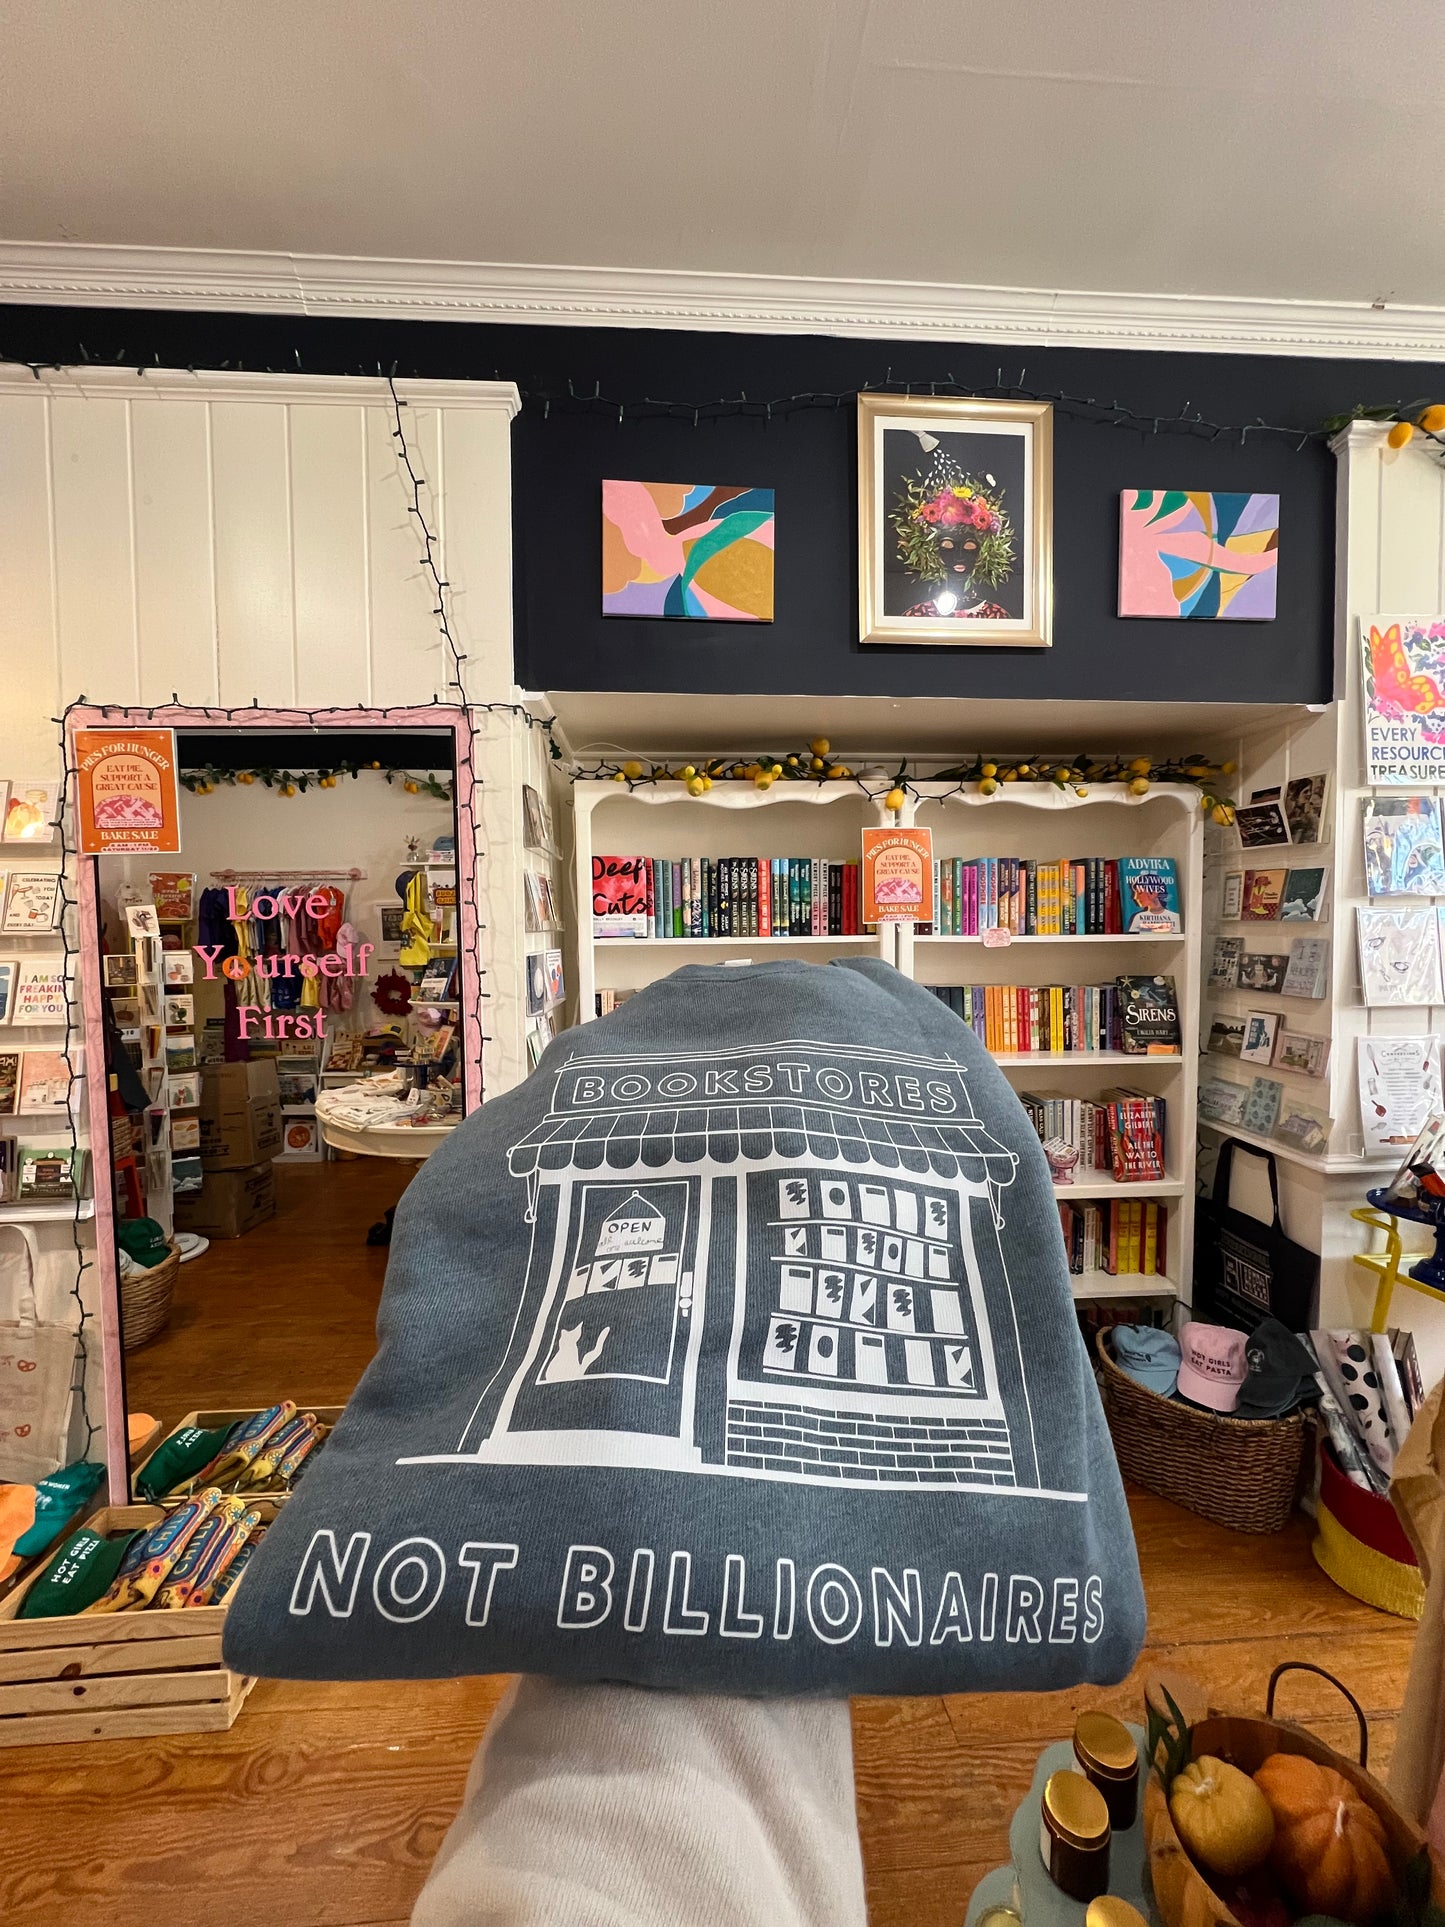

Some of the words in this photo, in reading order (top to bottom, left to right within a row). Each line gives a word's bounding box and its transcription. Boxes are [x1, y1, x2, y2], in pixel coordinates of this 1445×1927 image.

[1371, 727, 1417, 742] EVERY
[81, 750, 102, 772] PIES
[101, 743, 125, 756] FOR
[127, 743, 170, 771] HUNGER
[106, 764, 126, 773] EAT
[144, 773, 151, 781] A
[95, 783, 126, 791] GREAT
[127, 783, 158, 791] CAUSE
[101, 831, 131, 840] BAKE
[132, 830, 159, 840] SALE
[866, 843, 883, 860] PIES
[881, 838, 900, 848] FOR
[900, 838, 930, 859] HUNGER
[592, 856, 646, 885] Deep
[1127, 858, 1170, 870] ADVIKA
[1125, 875, 1174, 885] HOLLYWOOD
[1136, 884, 1166, 893] WIVES
[225, 885, 330, 921] Love
[592, 892, 649, 916] Cuts
[878, 905, 900, 913] BAKE
[192, 943, 375, 980] Yourself
[31, 975, 49, 983] AM
[50, 974, 64, 983] SO
[23, 995, 61, 1004] HAPPY
[18, 1004, 40, 1013] FOR
[42, 1004, 64, 1013] YOU
[1125, 1003, 1176, 1025] SIRENS
[236, 1005, 328, 1040] First
[572, 1063, 956, 1113] BOOKSTORES
[1120, 1111, 1157, 1120] ELIZABETH
[1124, 1120, 1153, 1129] GILBERT
[1128, 1141, 1141, 1150] ALL
[1142, 1141, 1154, 1149] THE
[1125, 1151, 1145, 1160] WAY
[1147, 1150, 1157, 1159] TO
[1125, 1161, 1137, 1169] THE
[1138, 1160, 1161, 1169] RIVER
[608, 1220, 652, 1234] OPEN
[624, 1236, 664, 1246] welcome
[1190, 1356, 1204, 1368] EAT
[1206, 1365, 1232, 1376] PASTA
[1191, 1350, 1206, 1362] HOT
[1208, 1358, 1231, 1368] GIRLS
[148, 1506, 191, 1553] CHILD
[172, 1519, 214, 1576] CHILD
[51, 1557, 72, 1584] HOT
[70, 1536, 91, 1557] GIRLS
[62, 1562, 81, 1586] EAT
[78, 1539, 101, 1561] PIZZA
[289, 1529, 519, 1626] NOT
[556, 1545, 1105, 1648] BILLIONAIRES
